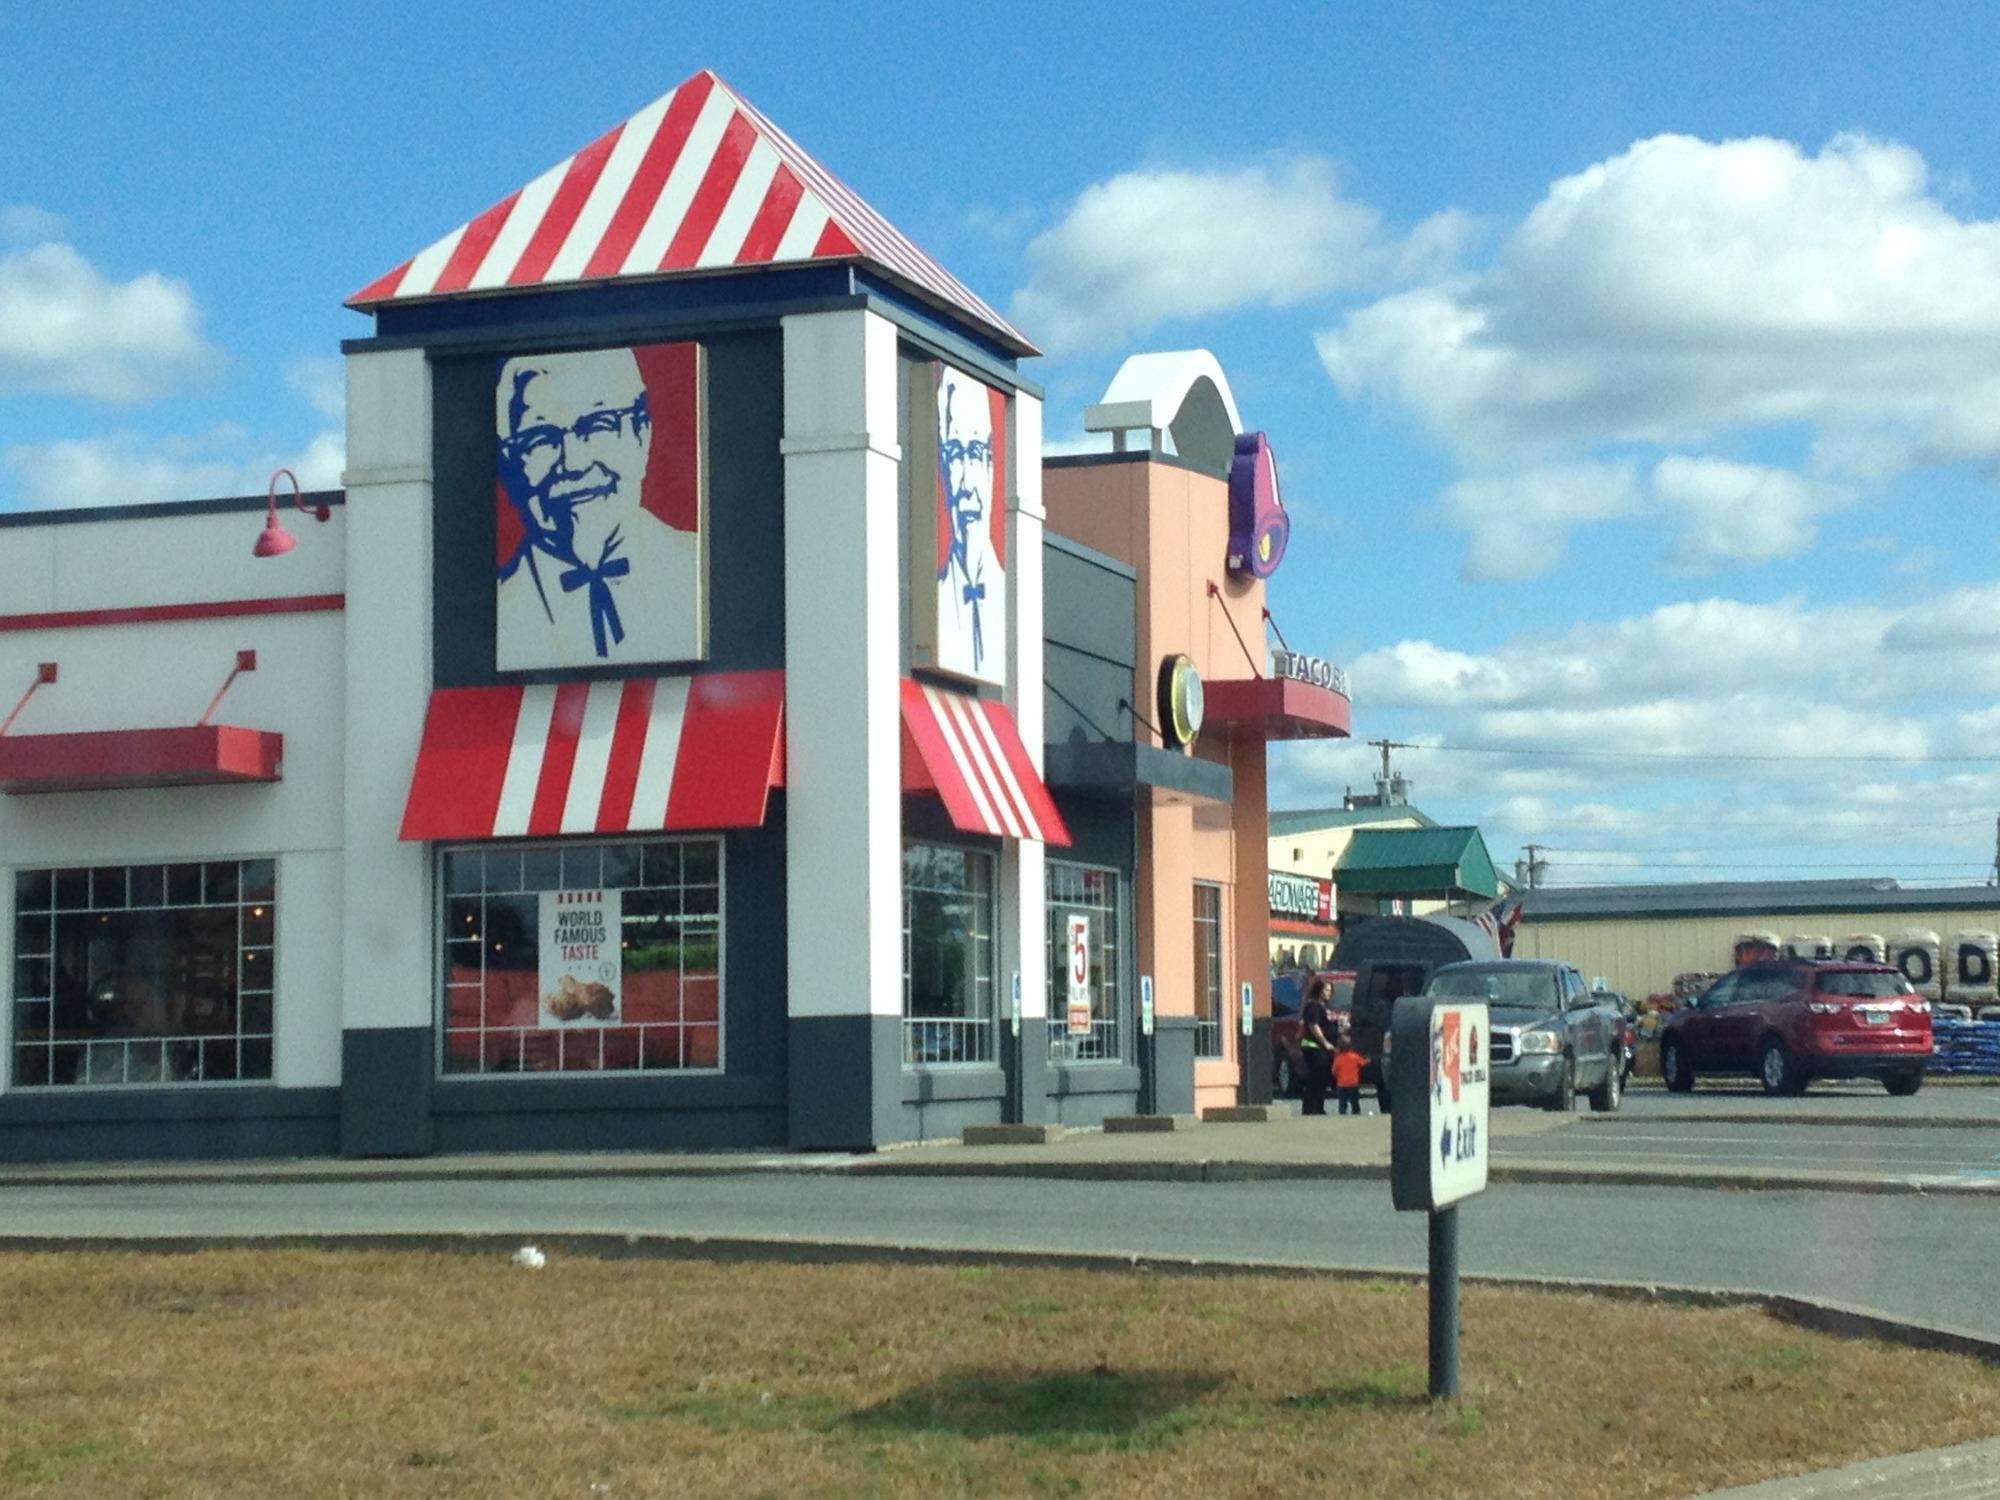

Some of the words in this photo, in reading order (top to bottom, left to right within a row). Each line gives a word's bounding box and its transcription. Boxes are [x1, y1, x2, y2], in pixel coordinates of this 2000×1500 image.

[1283, 651, 1331, 687] TACO
[1269, 879, 1318, 911] ARDWARE
[558, 910, 603, 927] WORLD
[554, 927, 606, 944] FAMOUS
[561, 944, 600, 961] TASTE
[1456, 1113, 1476, 1161] Exit
